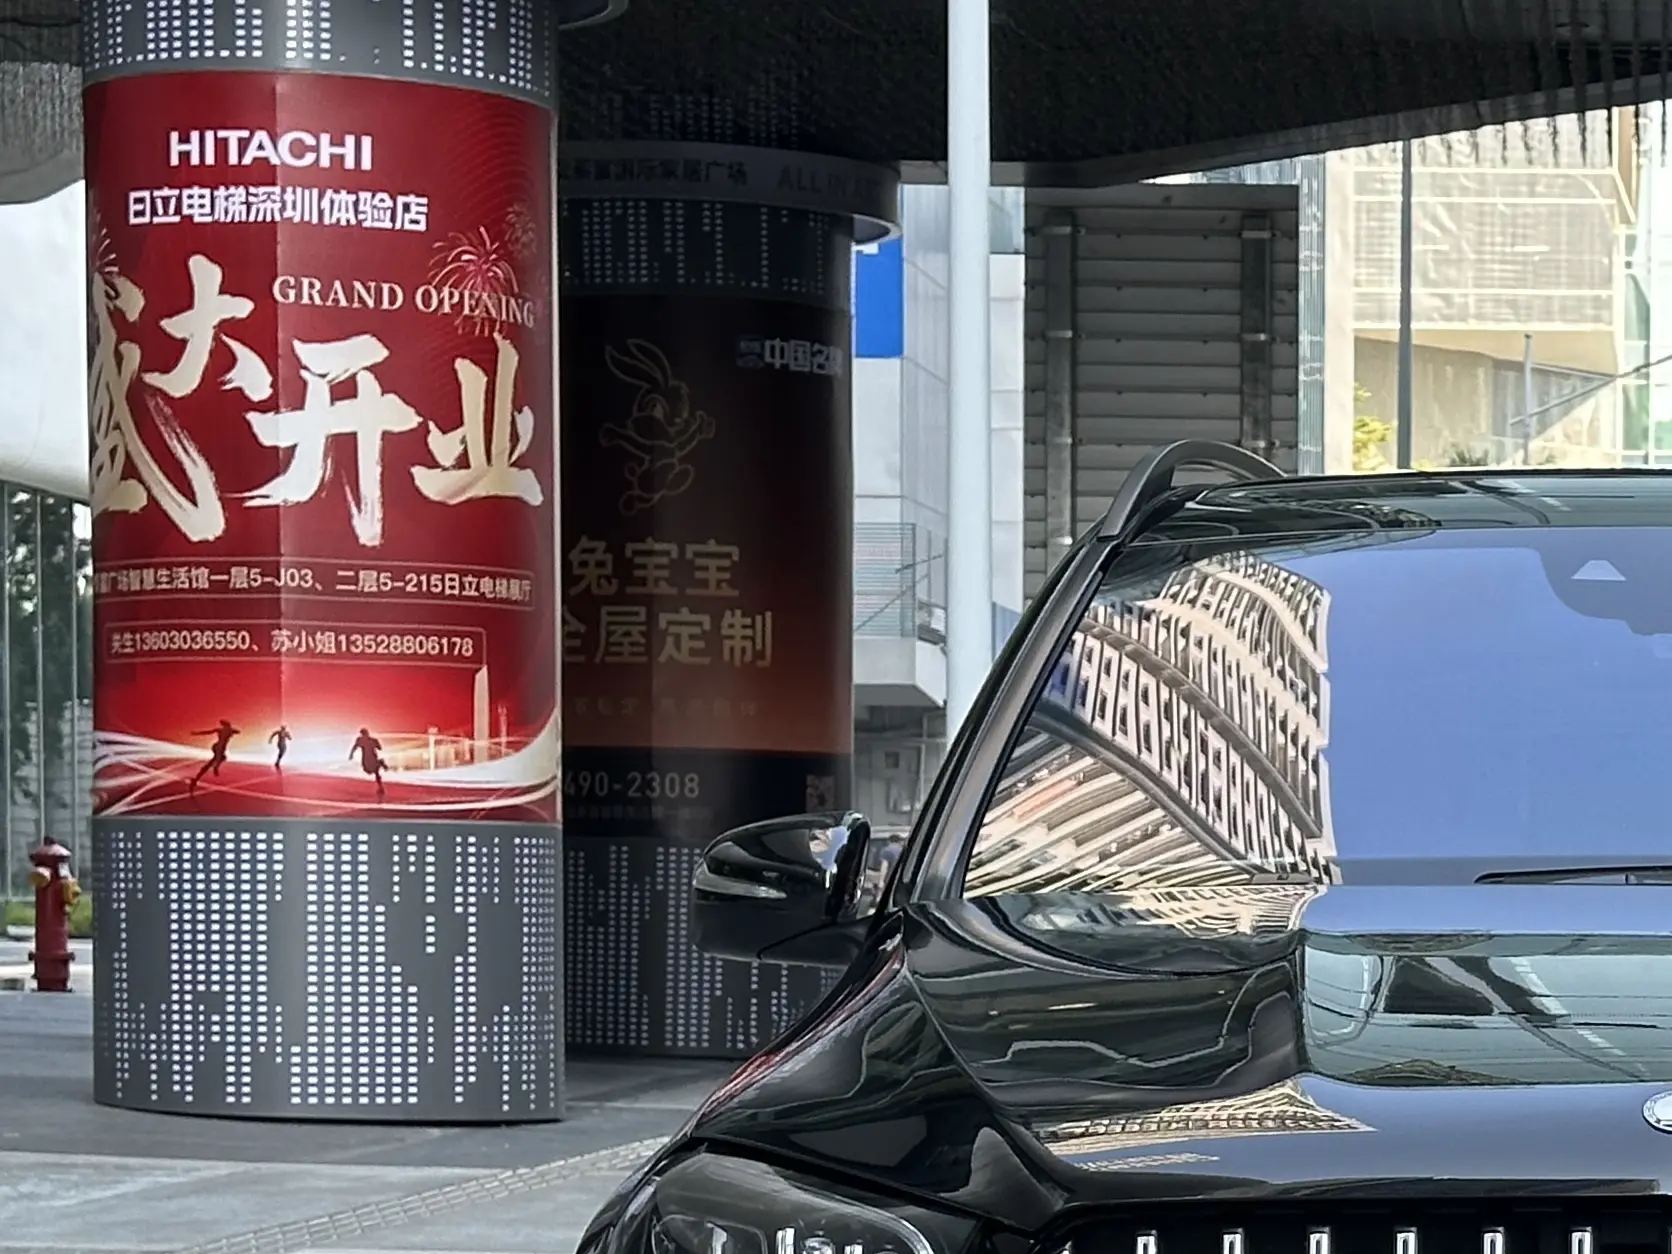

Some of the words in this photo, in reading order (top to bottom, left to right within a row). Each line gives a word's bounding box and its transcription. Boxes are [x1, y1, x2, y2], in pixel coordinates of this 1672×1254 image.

[169, 129, 373, 171] HITACHI
[127, 185, 429, 232] 日立电梯深圳体验店
[272, 275, 404, 311] GRAND
[414, 283, 535, 328] OPENING
[567, 533, 741, 598] 兔宝宝
